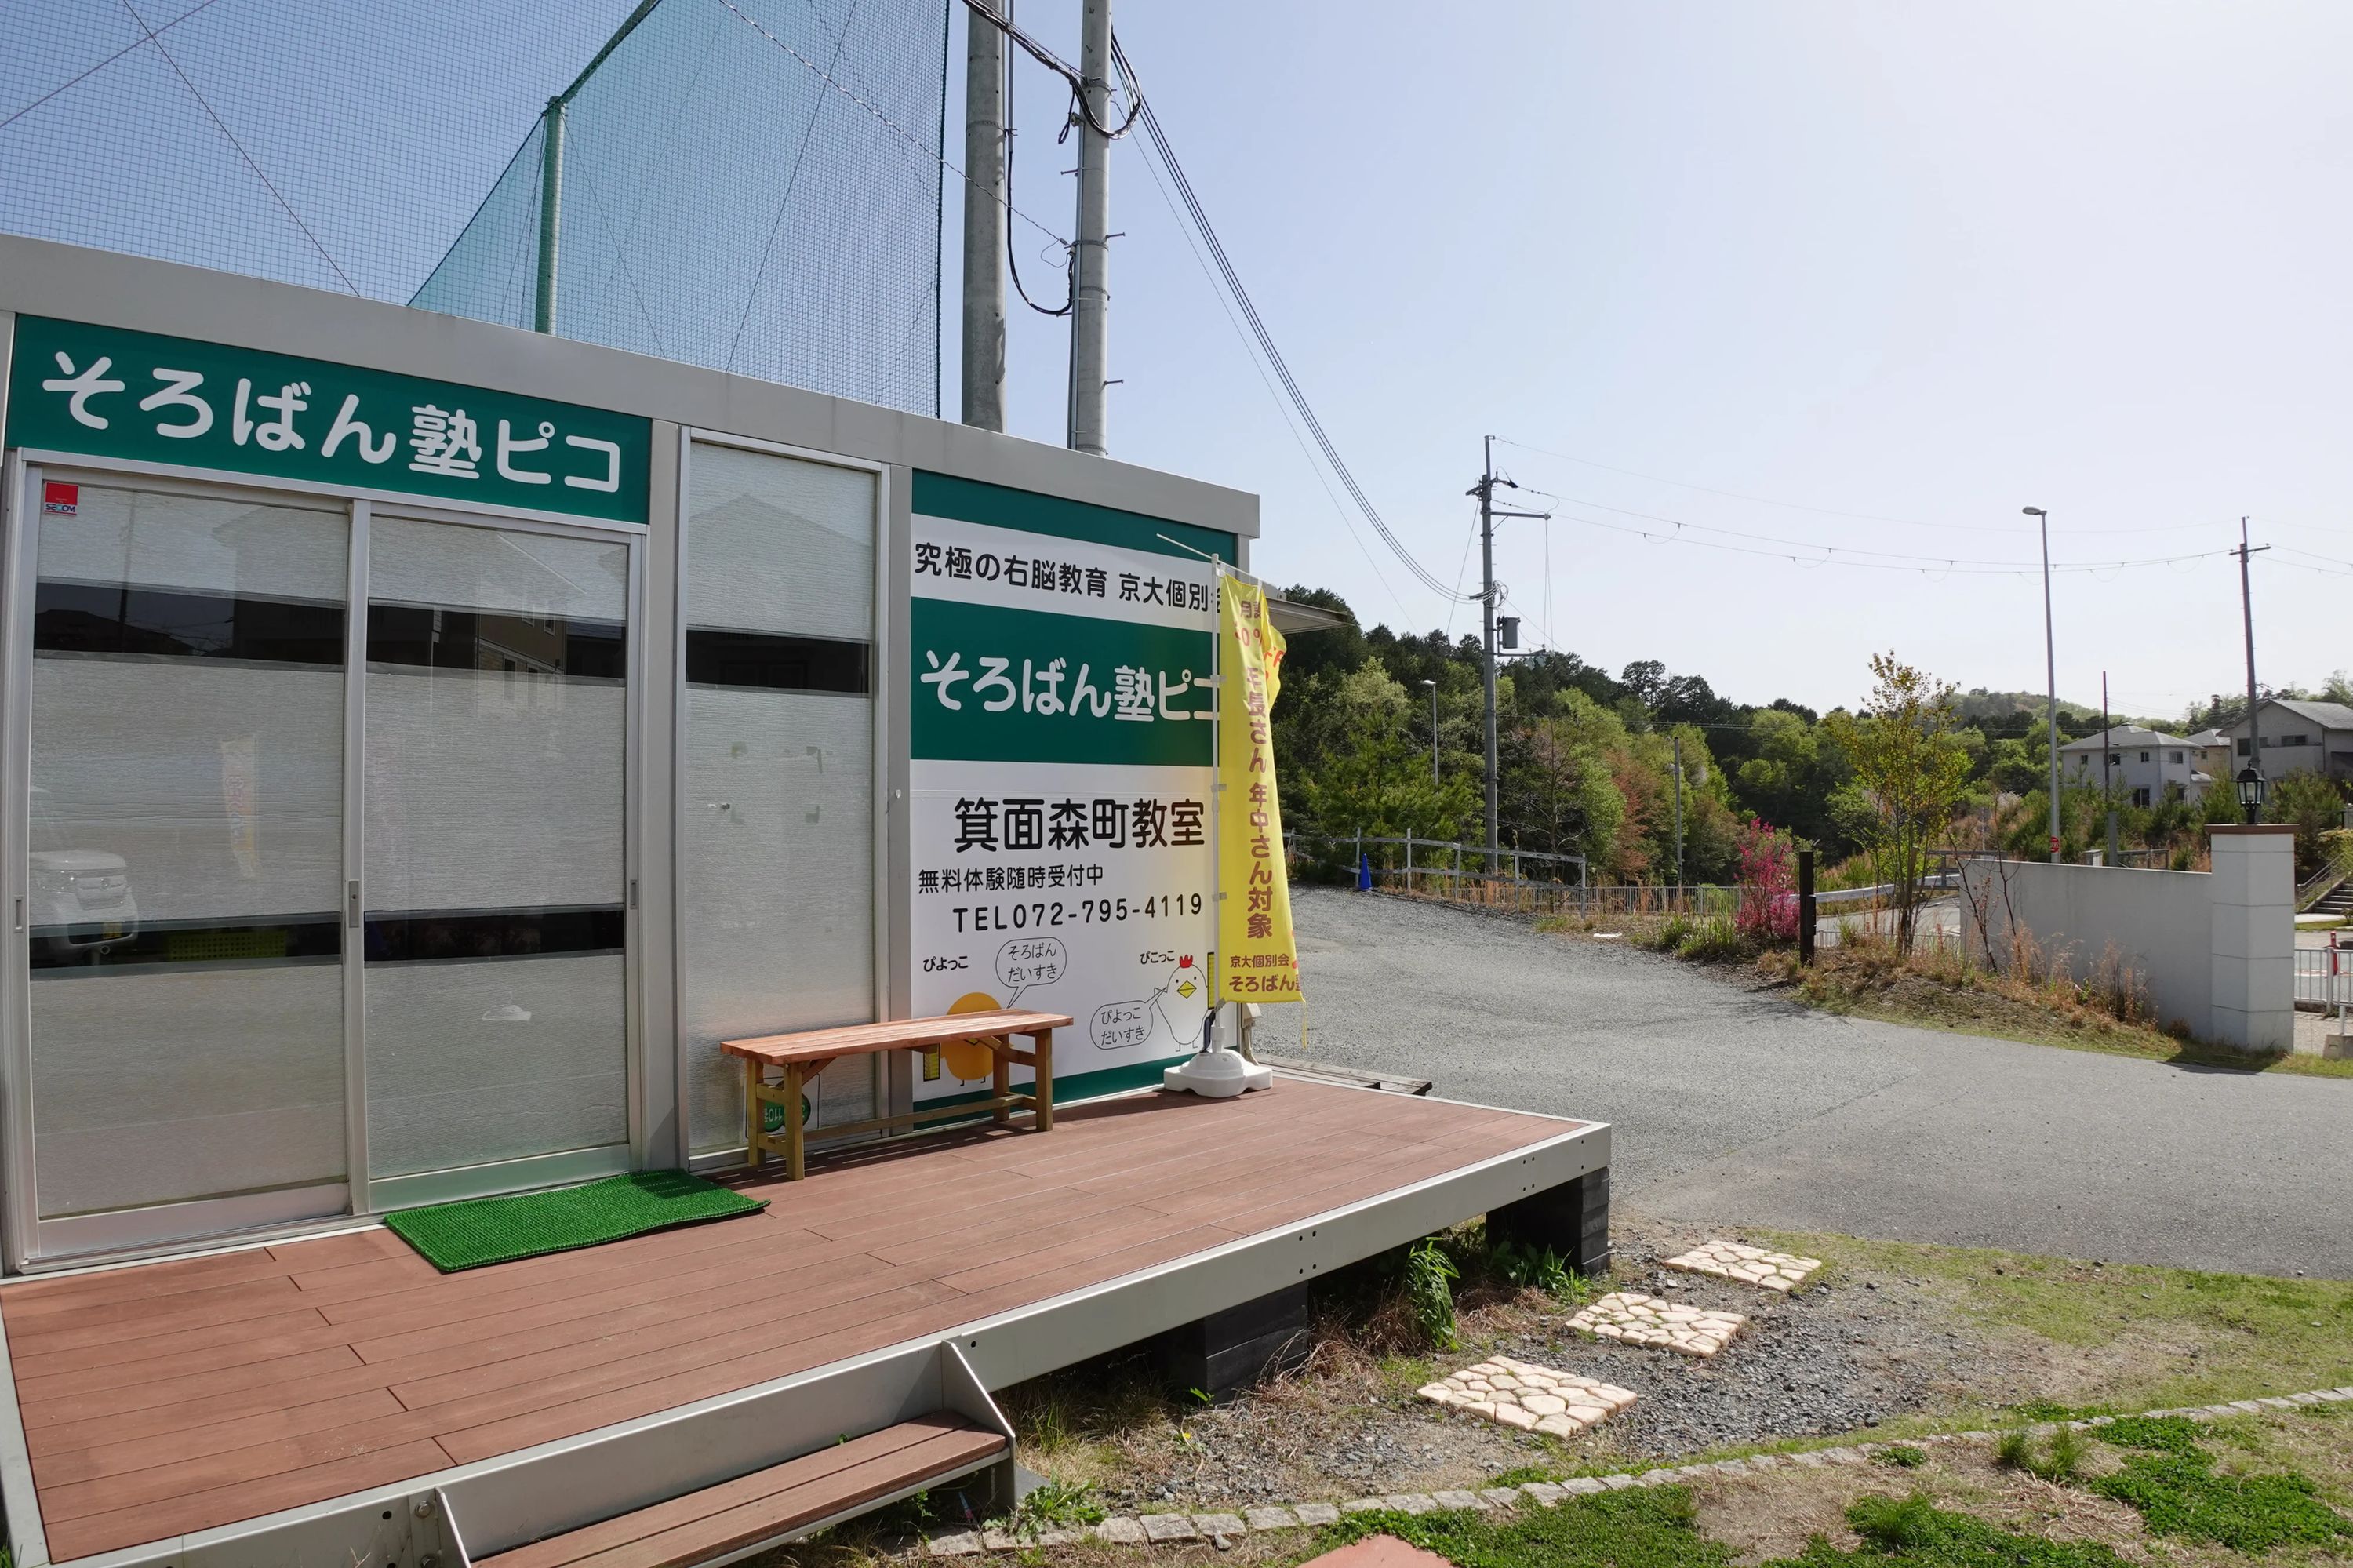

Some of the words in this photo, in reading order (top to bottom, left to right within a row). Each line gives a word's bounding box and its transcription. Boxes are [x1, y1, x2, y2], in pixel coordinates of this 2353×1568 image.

[42, 351, 621, 493] そろばん塾ピコ
[45, 503, 76, 513] SECOM
[915, 542, 1107, 598] 究極の右脳教育
[954, 797, 1206, 853] 箕面森町教室
[918, 863, 1104, 894] 無料体験随時受付中
[952, 893, 1202, 933] TEL072-795-4119
[1008, 942, 1057, 961] そろばん
[1230, 953, 1289, 969] 京大個別会
[1008, 963, 1057, 983] だいすき
[1228, 973, 1300, 993] そろばん
[1101, 1025, 1144, 1046] だいすき
